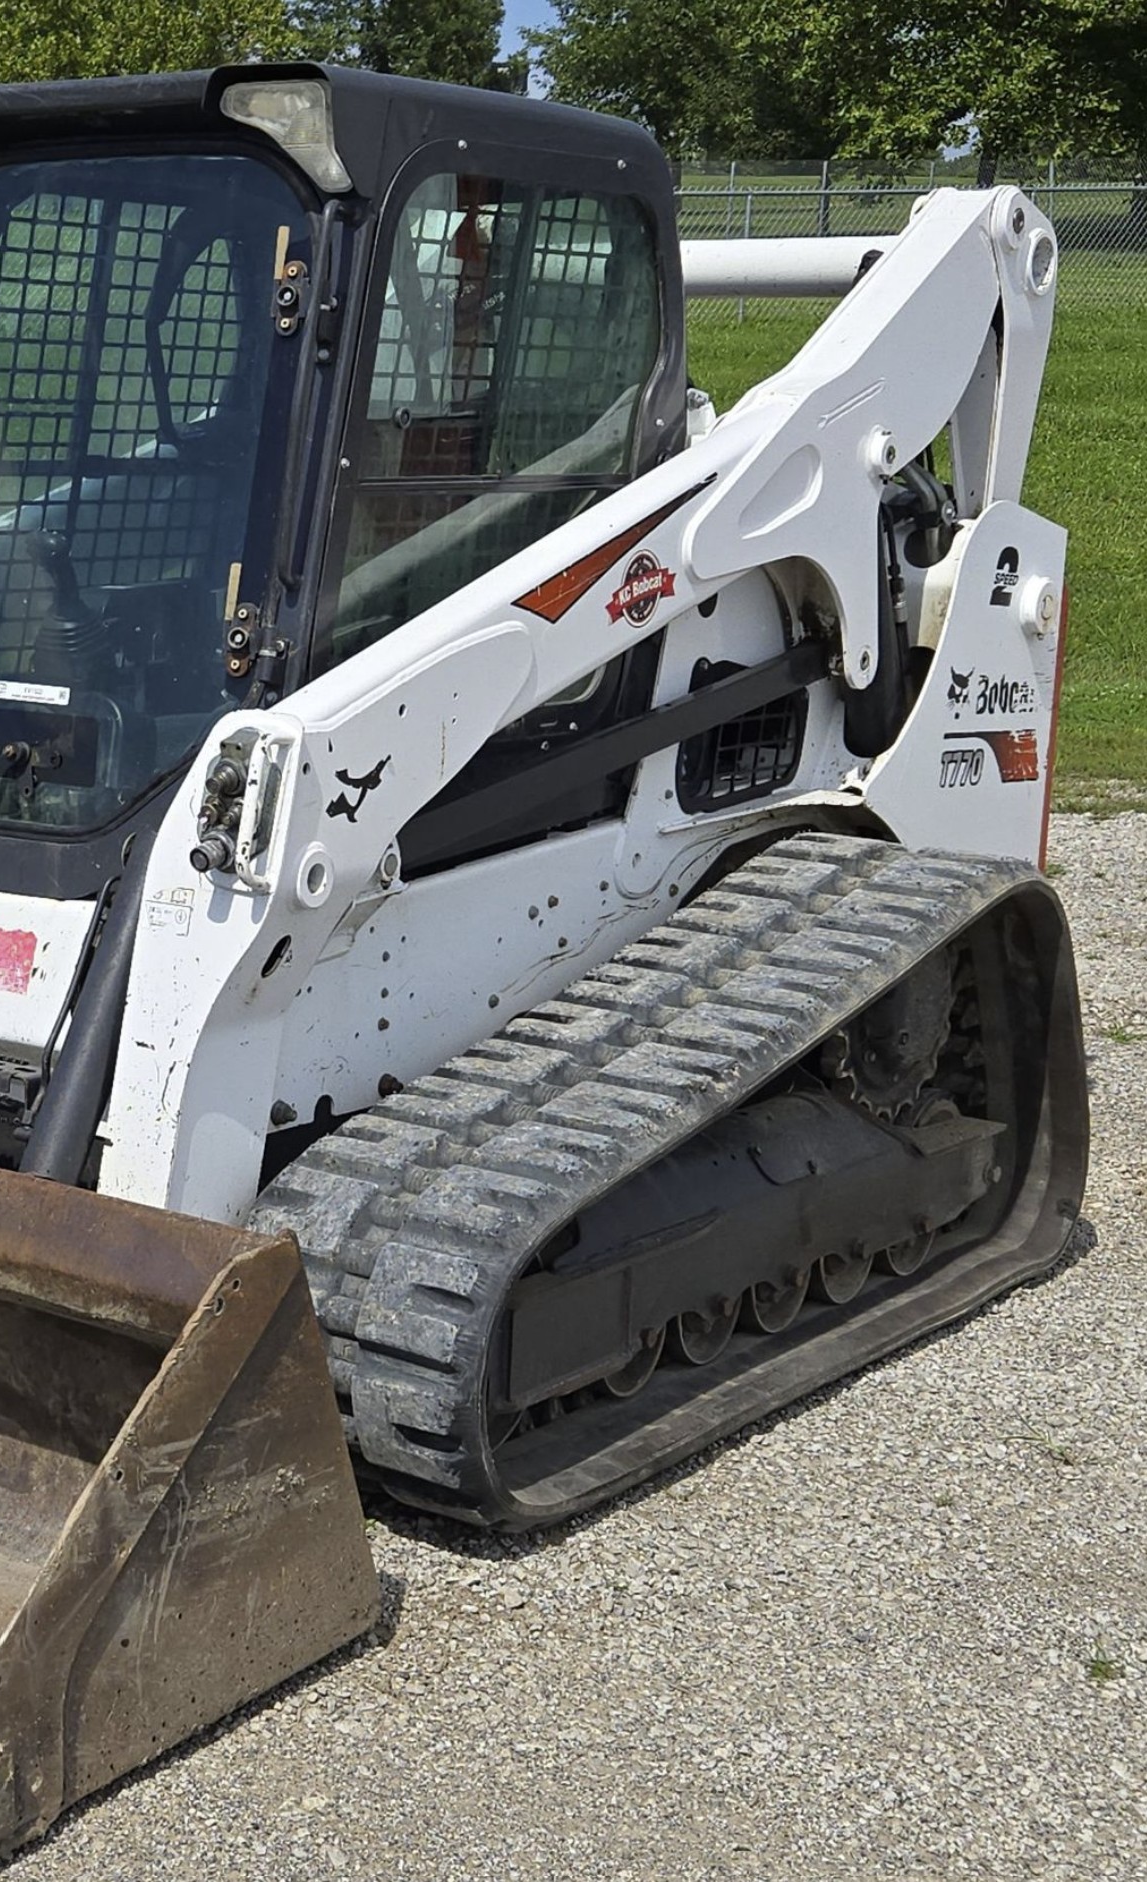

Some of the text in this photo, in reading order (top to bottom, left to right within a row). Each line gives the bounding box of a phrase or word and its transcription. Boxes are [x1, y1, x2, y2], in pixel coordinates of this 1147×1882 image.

[618, 571, 662, 605] KC Bobcat
[990, 546, 1019, 606] 2
[994, 572, 1019, 585] SPEED
[940, 748, 984, 788] T770
